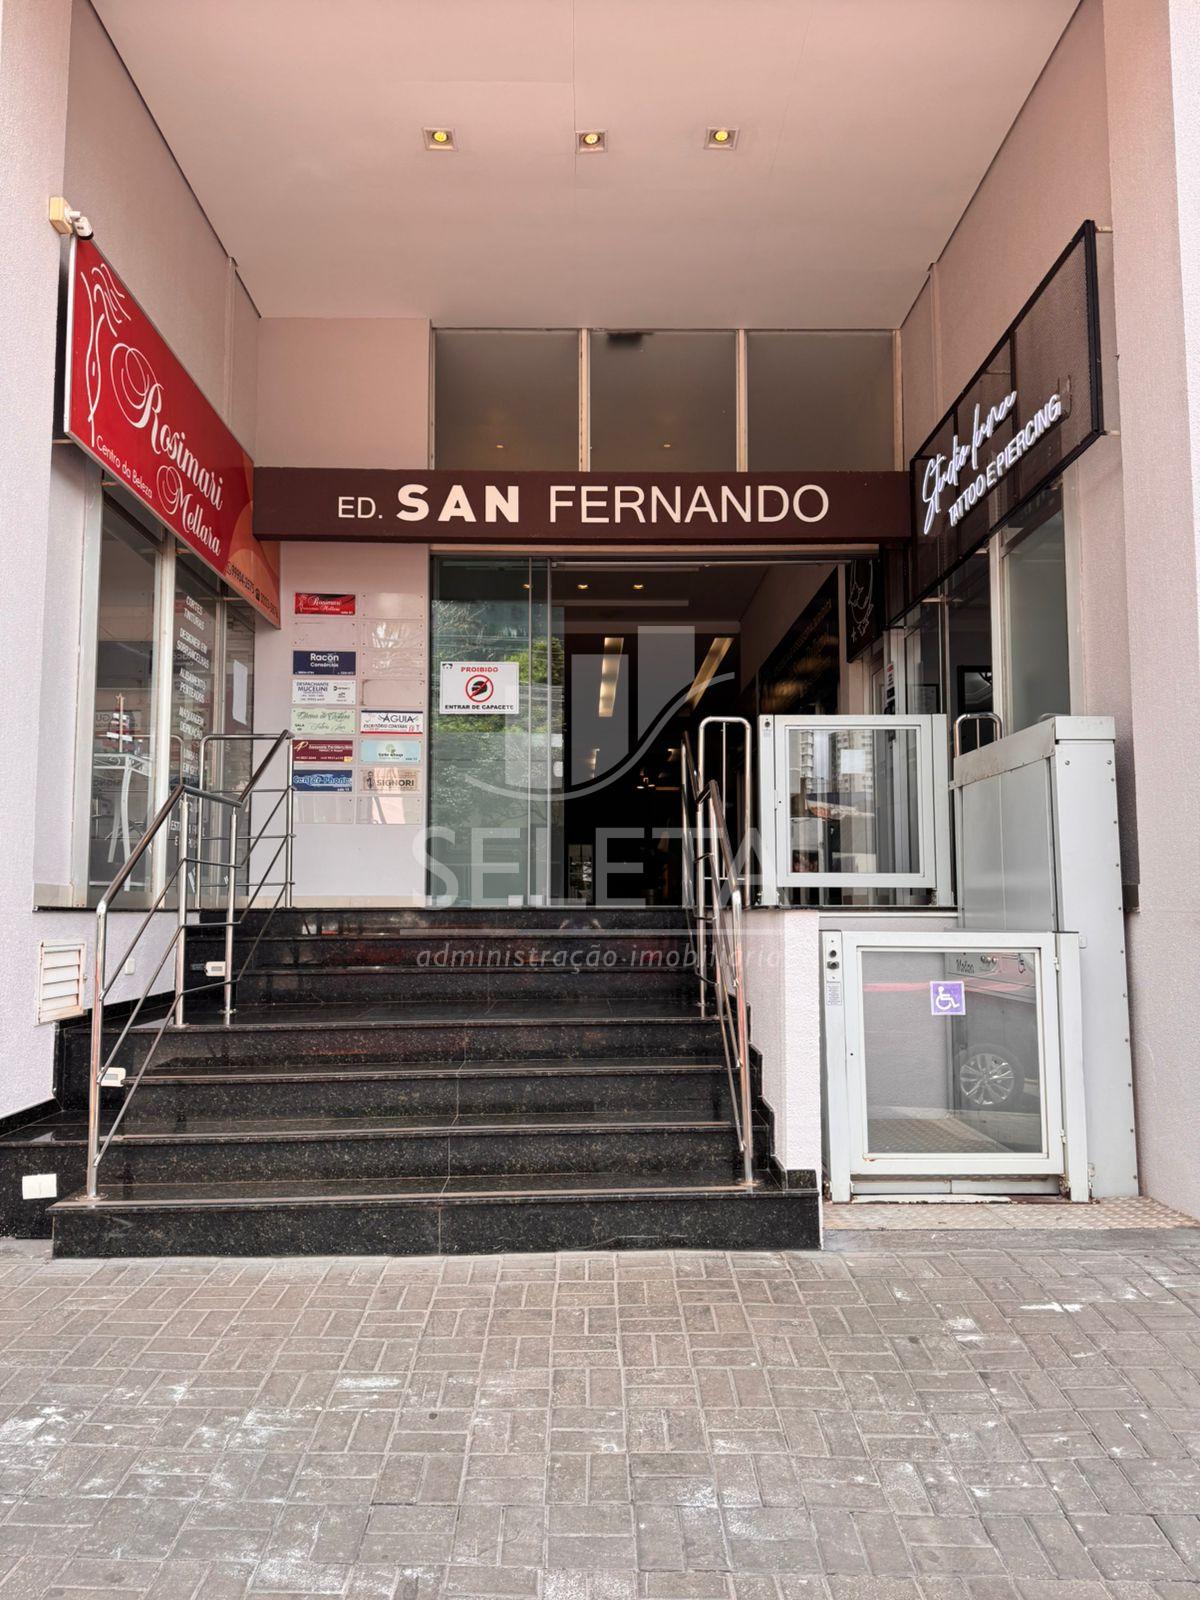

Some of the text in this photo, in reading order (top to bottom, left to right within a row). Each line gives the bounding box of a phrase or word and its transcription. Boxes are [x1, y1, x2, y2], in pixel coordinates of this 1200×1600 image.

[110, 342, 224, 512] Rosimari
[96, 434, 121, 469] Centro
[132, 469, 153, 499] Beleza
[922, 434, 971, 536] Studio
[948, 393, 1063, 528] TATTOO E PIERCING
[156, 464, 222, 557] Mellara
[337, 483, 829, 525] ED. SAN FERNANDO
[310, 653, 339, 661] Racon
[383, 713, 414, 723] ÁGUIA
[376, 779, 415, 787] SIGNORI
